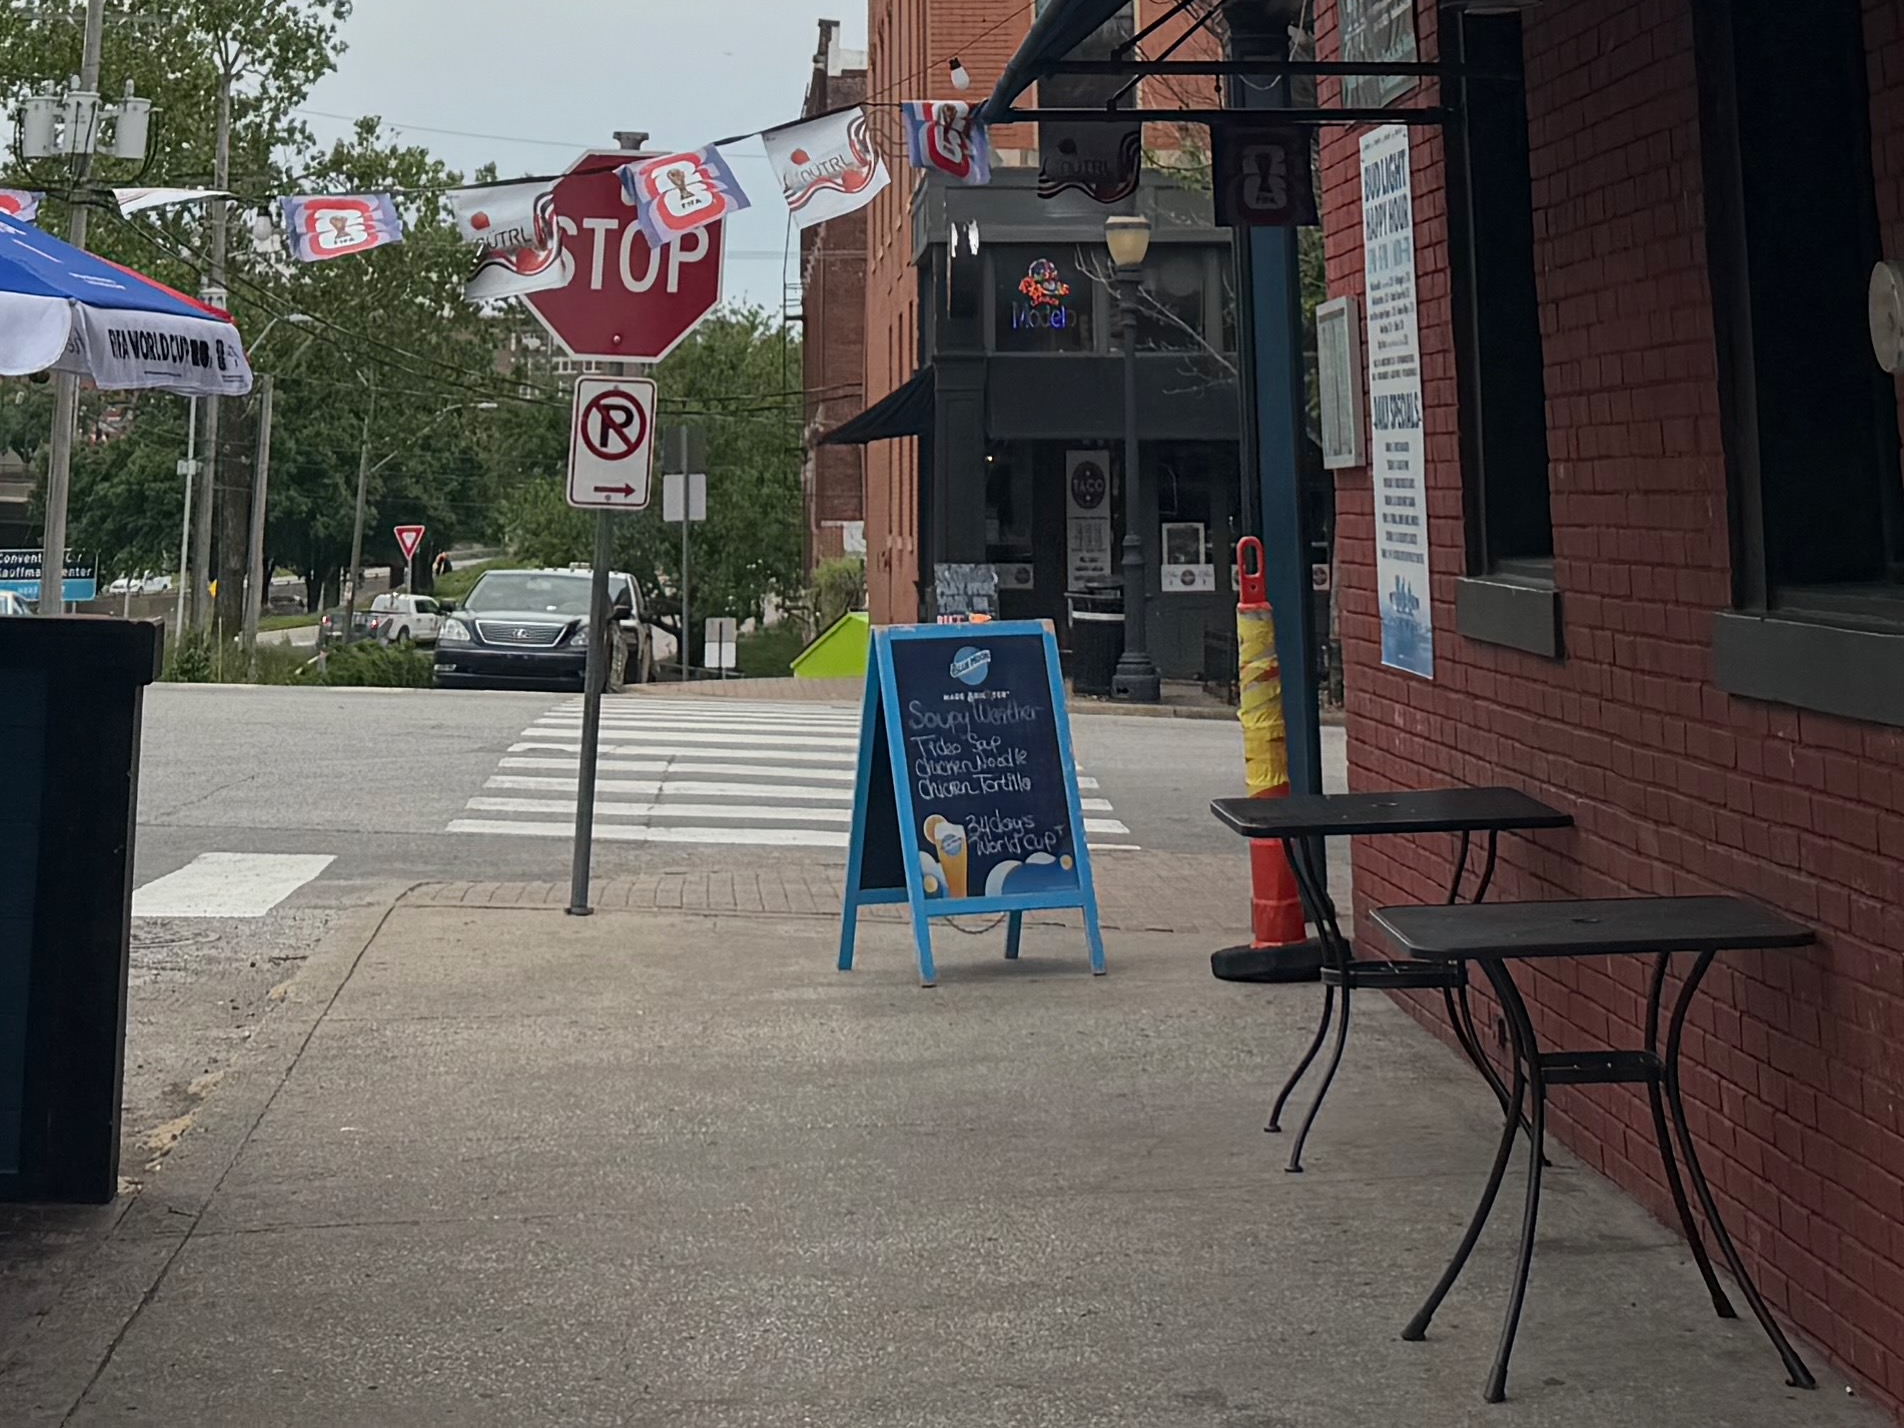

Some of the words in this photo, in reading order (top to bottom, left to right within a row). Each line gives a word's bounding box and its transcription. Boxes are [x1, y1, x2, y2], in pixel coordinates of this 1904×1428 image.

[554, 215, 710, 294] STOP
[127, 329, 171, 362] WORLD
[1072, 479, 1104, 494] TACO
[61, 567, 93, 577] enter
[908, 699, 971, 734] Soupy
